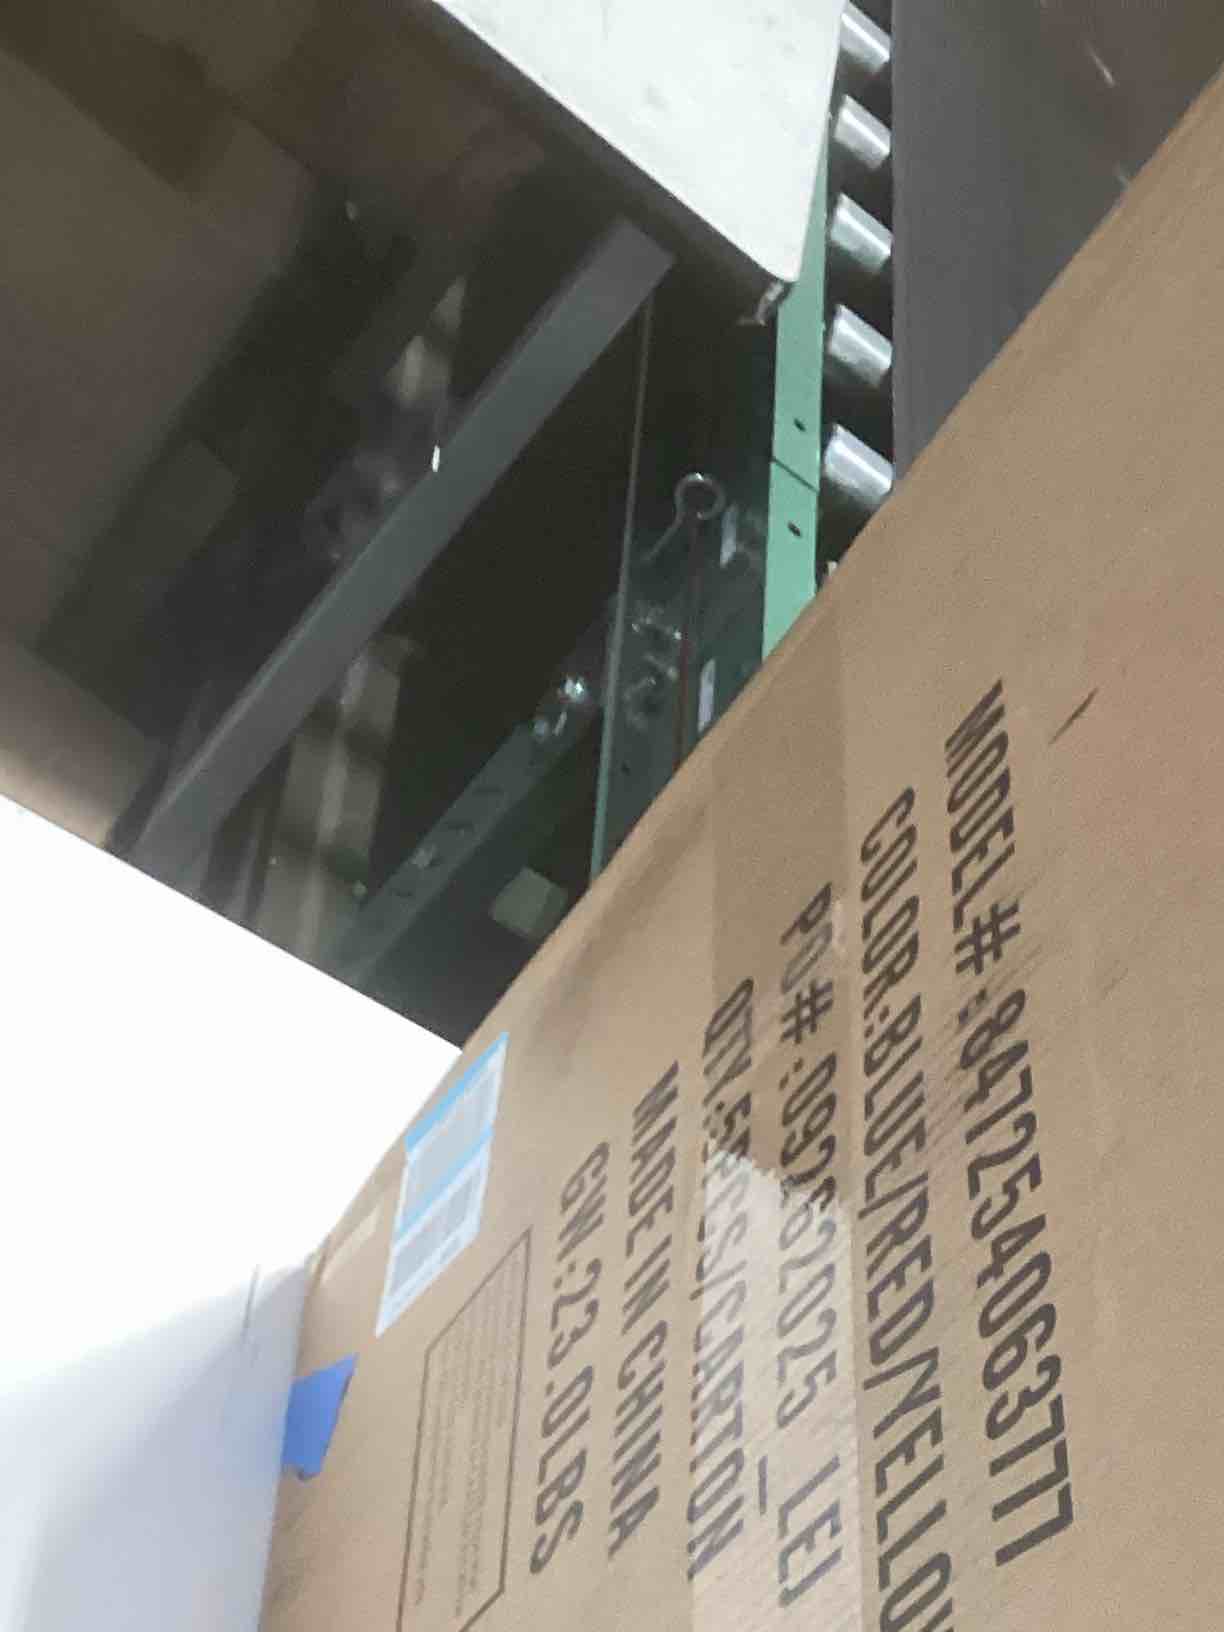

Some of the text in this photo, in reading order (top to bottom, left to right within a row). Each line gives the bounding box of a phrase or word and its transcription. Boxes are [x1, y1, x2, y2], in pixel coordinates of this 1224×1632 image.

[608, 1060, 679, 1562] MADE IN CHINA
